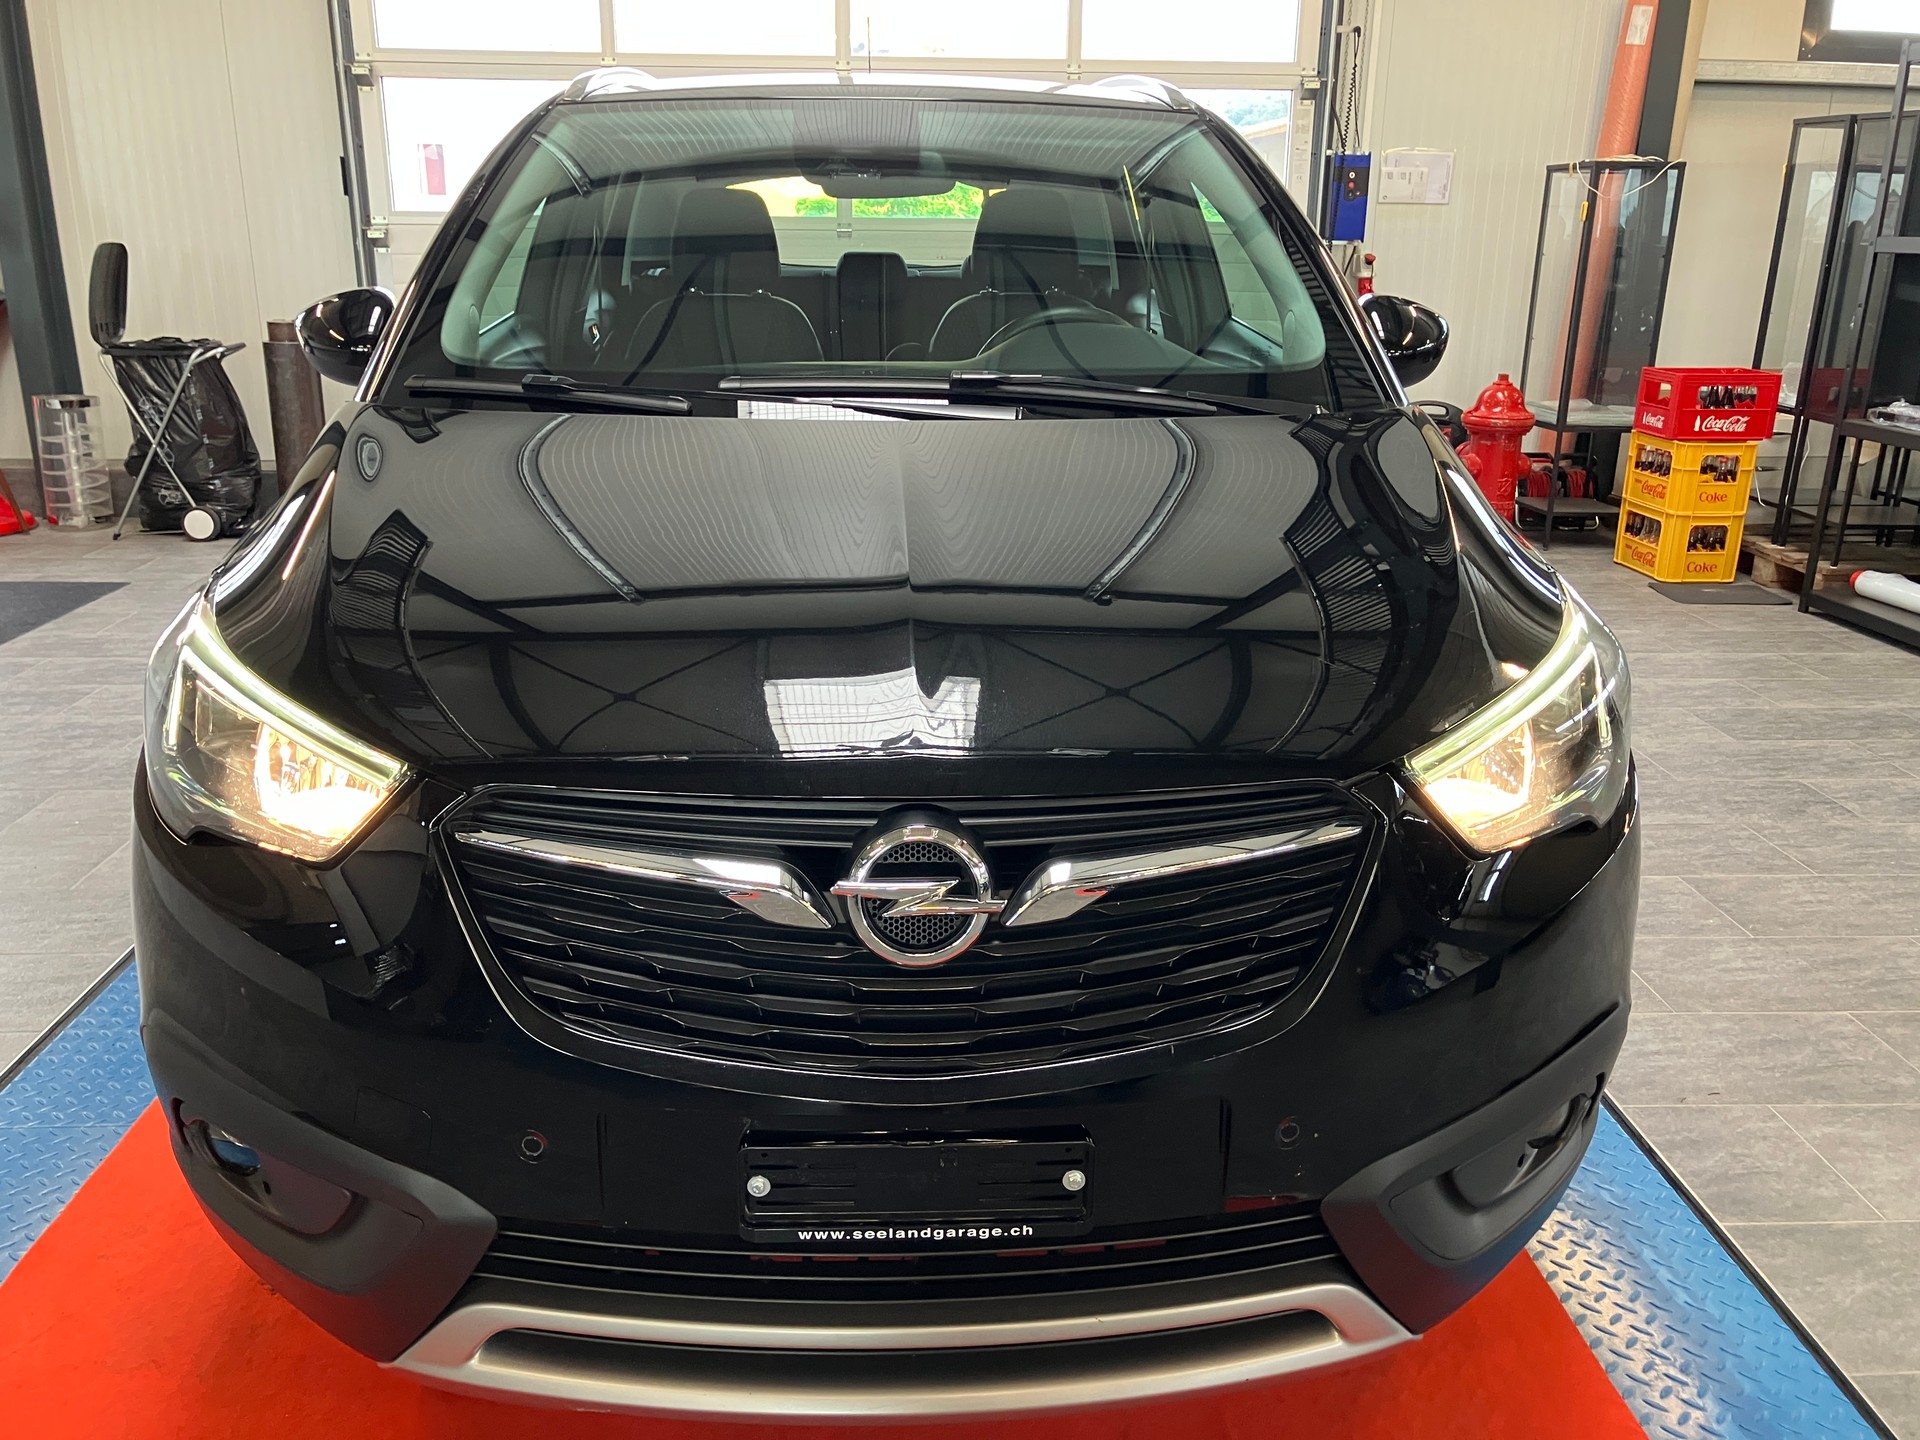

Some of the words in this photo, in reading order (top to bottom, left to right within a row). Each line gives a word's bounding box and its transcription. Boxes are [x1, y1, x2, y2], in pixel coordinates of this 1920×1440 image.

[1699, 491, 1728, 503] Coke
[1686, 561, 1718, 573] Coke
[797, 1225, 1034, 1241] www.seelandgarage.ch
